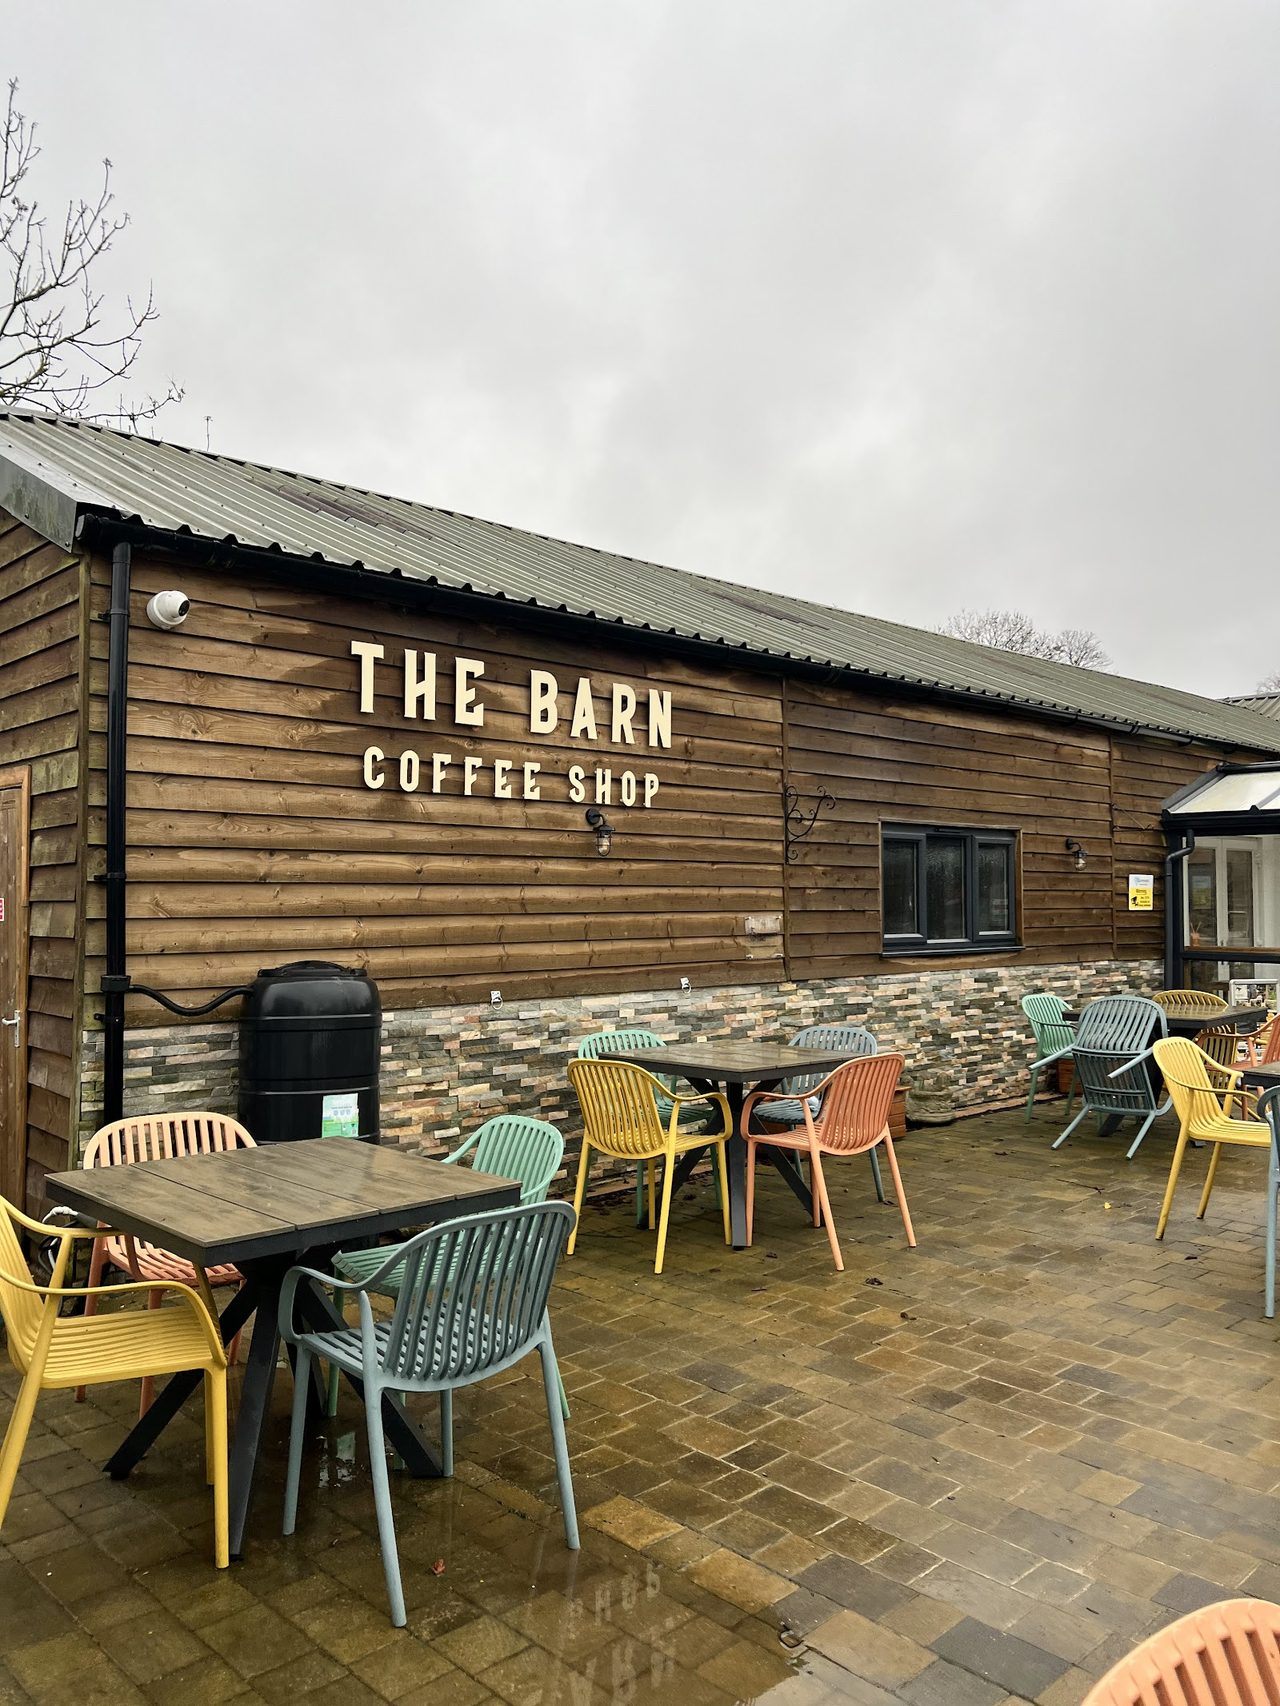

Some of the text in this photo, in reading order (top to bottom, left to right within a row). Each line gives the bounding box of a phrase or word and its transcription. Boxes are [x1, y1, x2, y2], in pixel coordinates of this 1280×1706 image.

[351, 640, 672, 749] THE BARN
[363, 746, 660, 808] COFFEE SHOP
